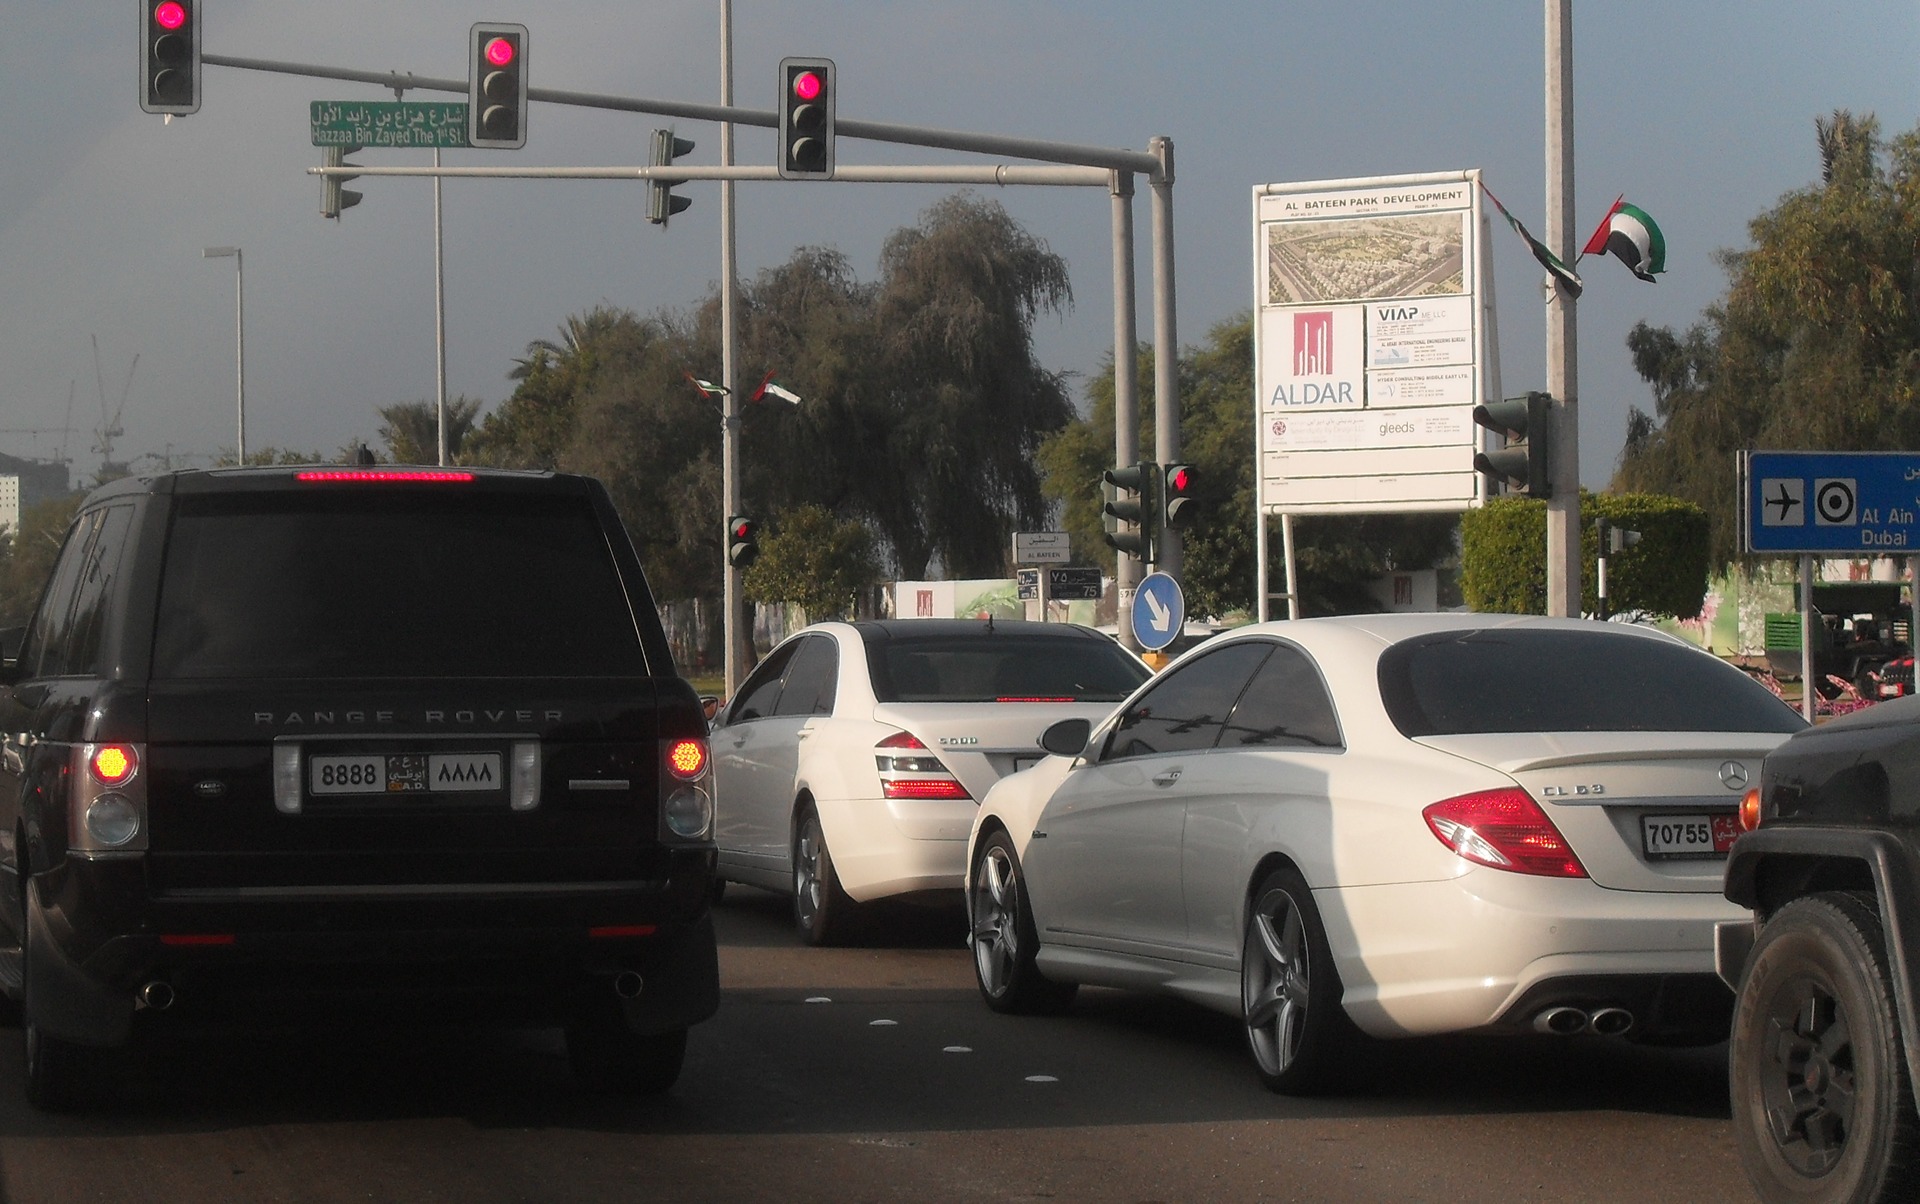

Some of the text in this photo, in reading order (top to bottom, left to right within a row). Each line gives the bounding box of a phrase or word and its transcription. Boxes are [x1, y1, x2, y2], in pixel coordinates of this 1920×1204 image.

[346, 106, 371, 127] زايد
[375, 110, 391, 127] بن
[394, 107, 424, 128] هزاع
[429, 106, 463, 126] شارع
[312, 126, 464, 146] Hazzaa Bin Zayed The 1st St.
[1285, 191, 1463, 210] AL BATEEN PARK DEVELOPMENT
[1271, 382, 1354, 405] ALDAR
[1379, 421, 1415, 436] gleeds
[1861, 508, 1913, 524] Al Ain
[1861, 529, 1907, 545] Dubai
[1083, 586, 1097, 597] 75
[254, 710, 562, 724] RANGE ROVER
[321, 763, 377, 786] 8888
[438, 762, 492, 783] ٨٨٨٨
[1649, 824, 1710, 845] 70755
